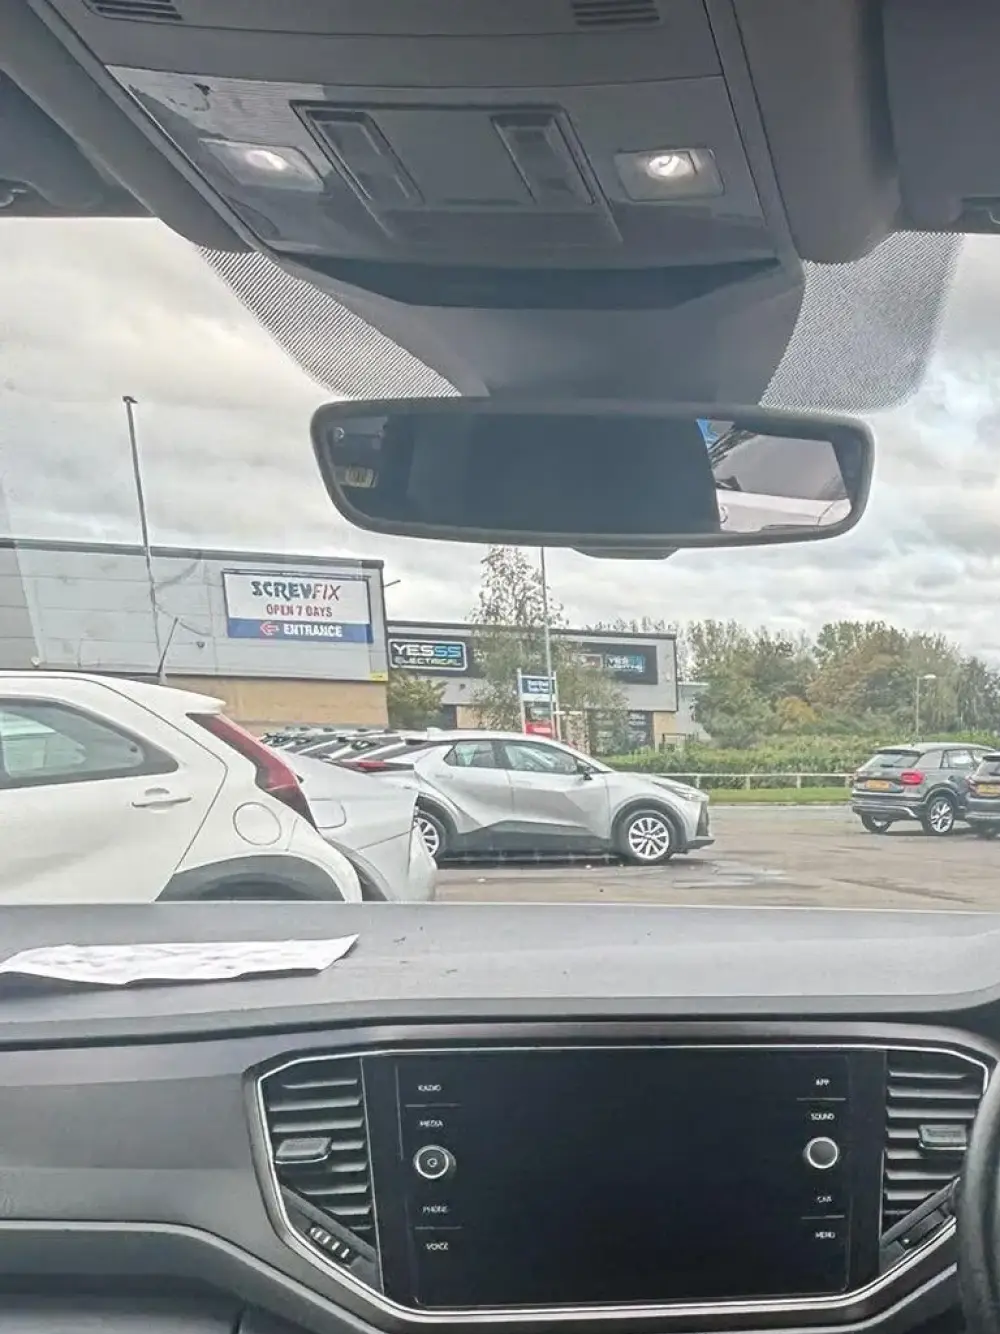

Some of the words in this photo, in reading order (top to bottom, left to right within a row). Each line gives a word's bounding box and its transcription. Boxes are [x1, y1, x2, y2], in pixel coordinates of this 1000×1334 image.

[266, 603, 294, 616] OPEN
[296, 605, 303, 617] 7
[305, 605, 333, 618] DAYS
[283, 623, 343, 638] ENTRANCE
[392, 642, 462, 658] YESSS
